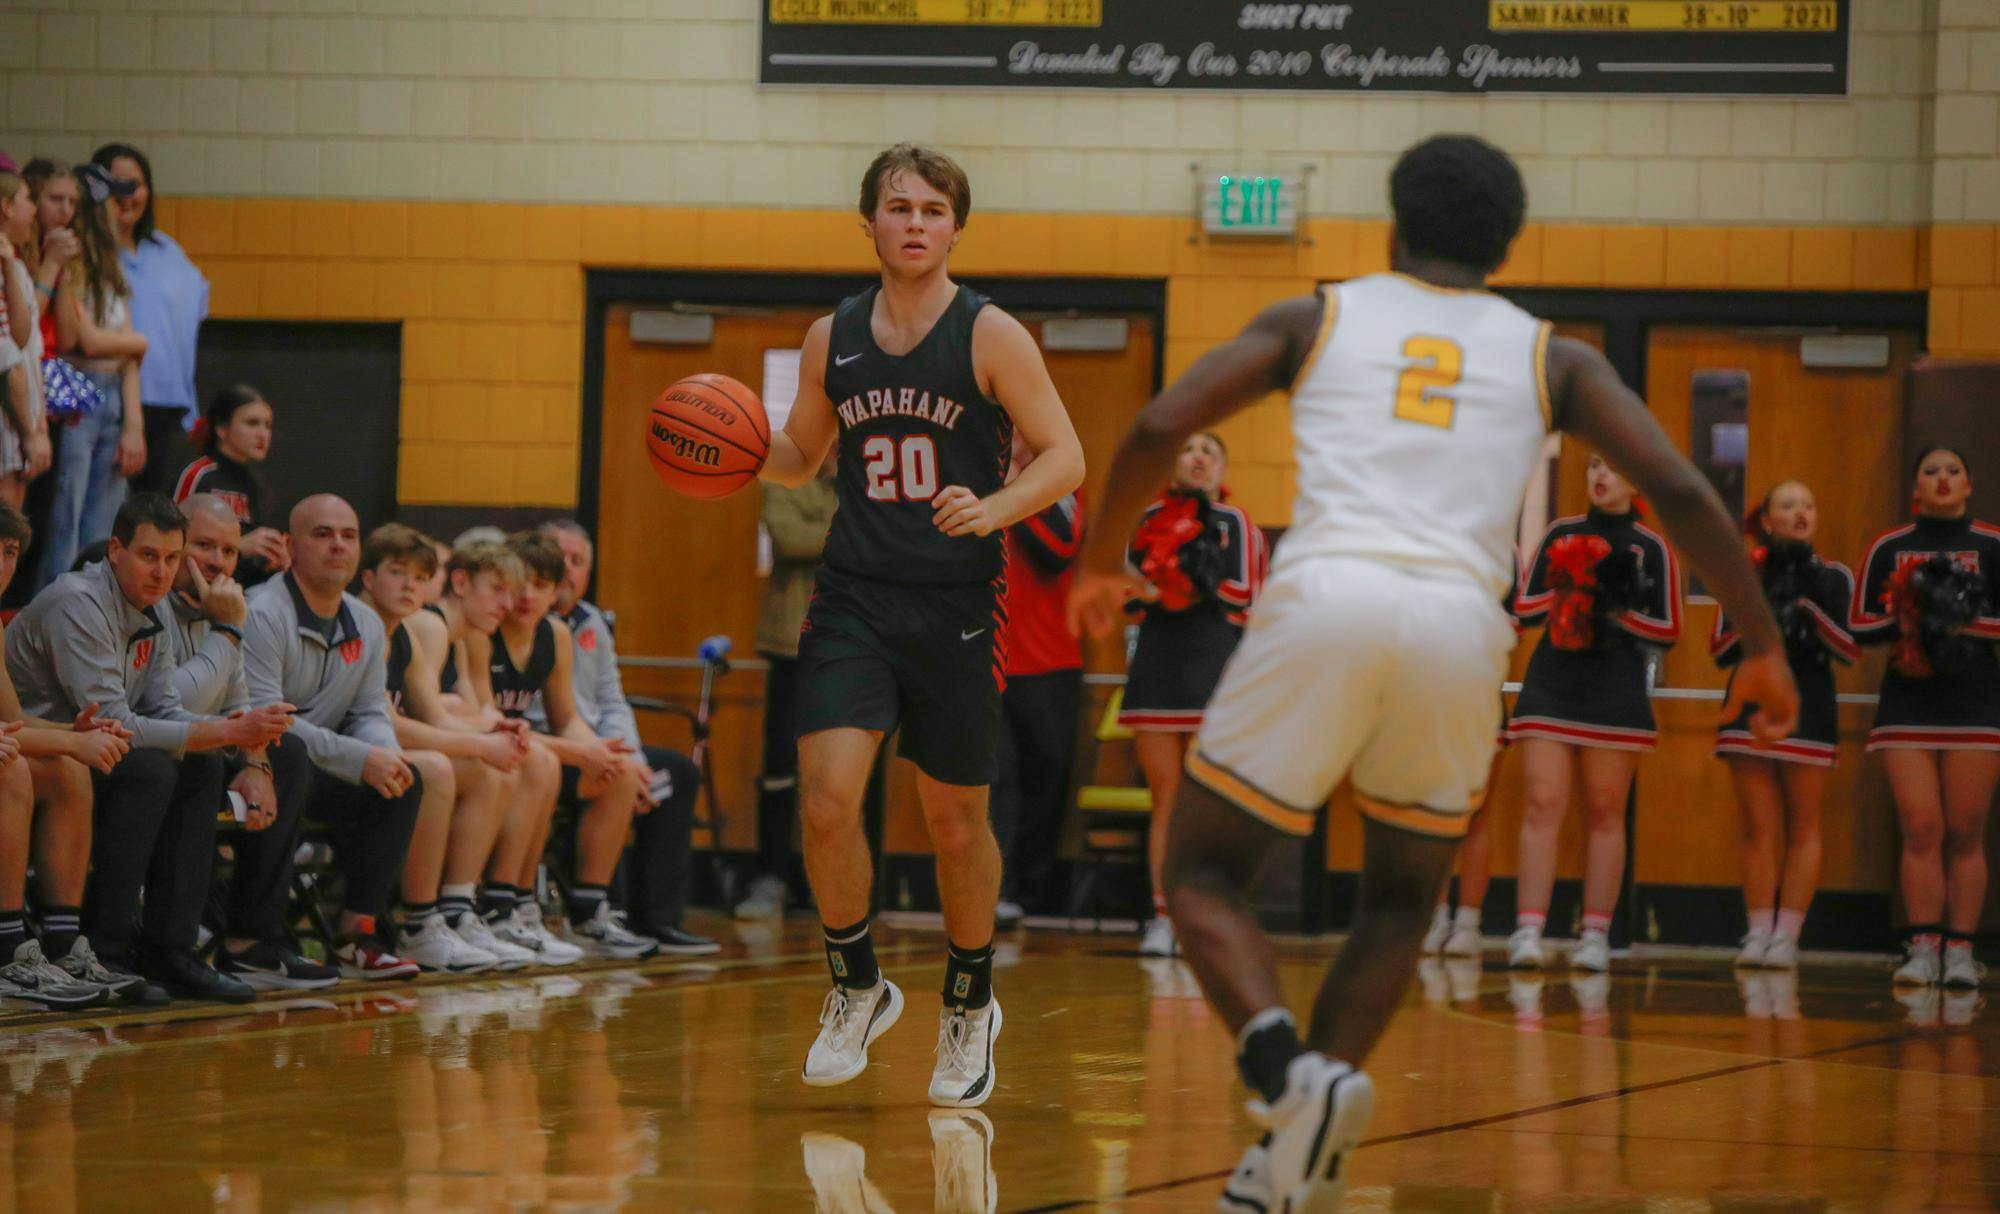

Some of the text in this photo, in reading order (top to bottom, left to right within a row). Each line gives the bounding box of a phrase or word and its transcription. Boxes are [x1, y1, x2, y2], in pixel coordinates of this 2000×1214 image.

[1238, 3, 1353, 30] SHOT PUT
[1499, 3, 1545, 24] SAMI
[1553, 4, 1630, 25] FARMER
[1783, 4, 1833, 27] 2021
[1008, 40, 1582, 88] Donated By Our 2010 Corporate Sponsors
[1219, 175, 1284, 227] EXIT
[1392, 334, 1463, 431] 2
[837, 387, 964, 431] WAPAHANI
[651, 420, 721, 467] Wilson
[863, 433, 941, 502] 20
